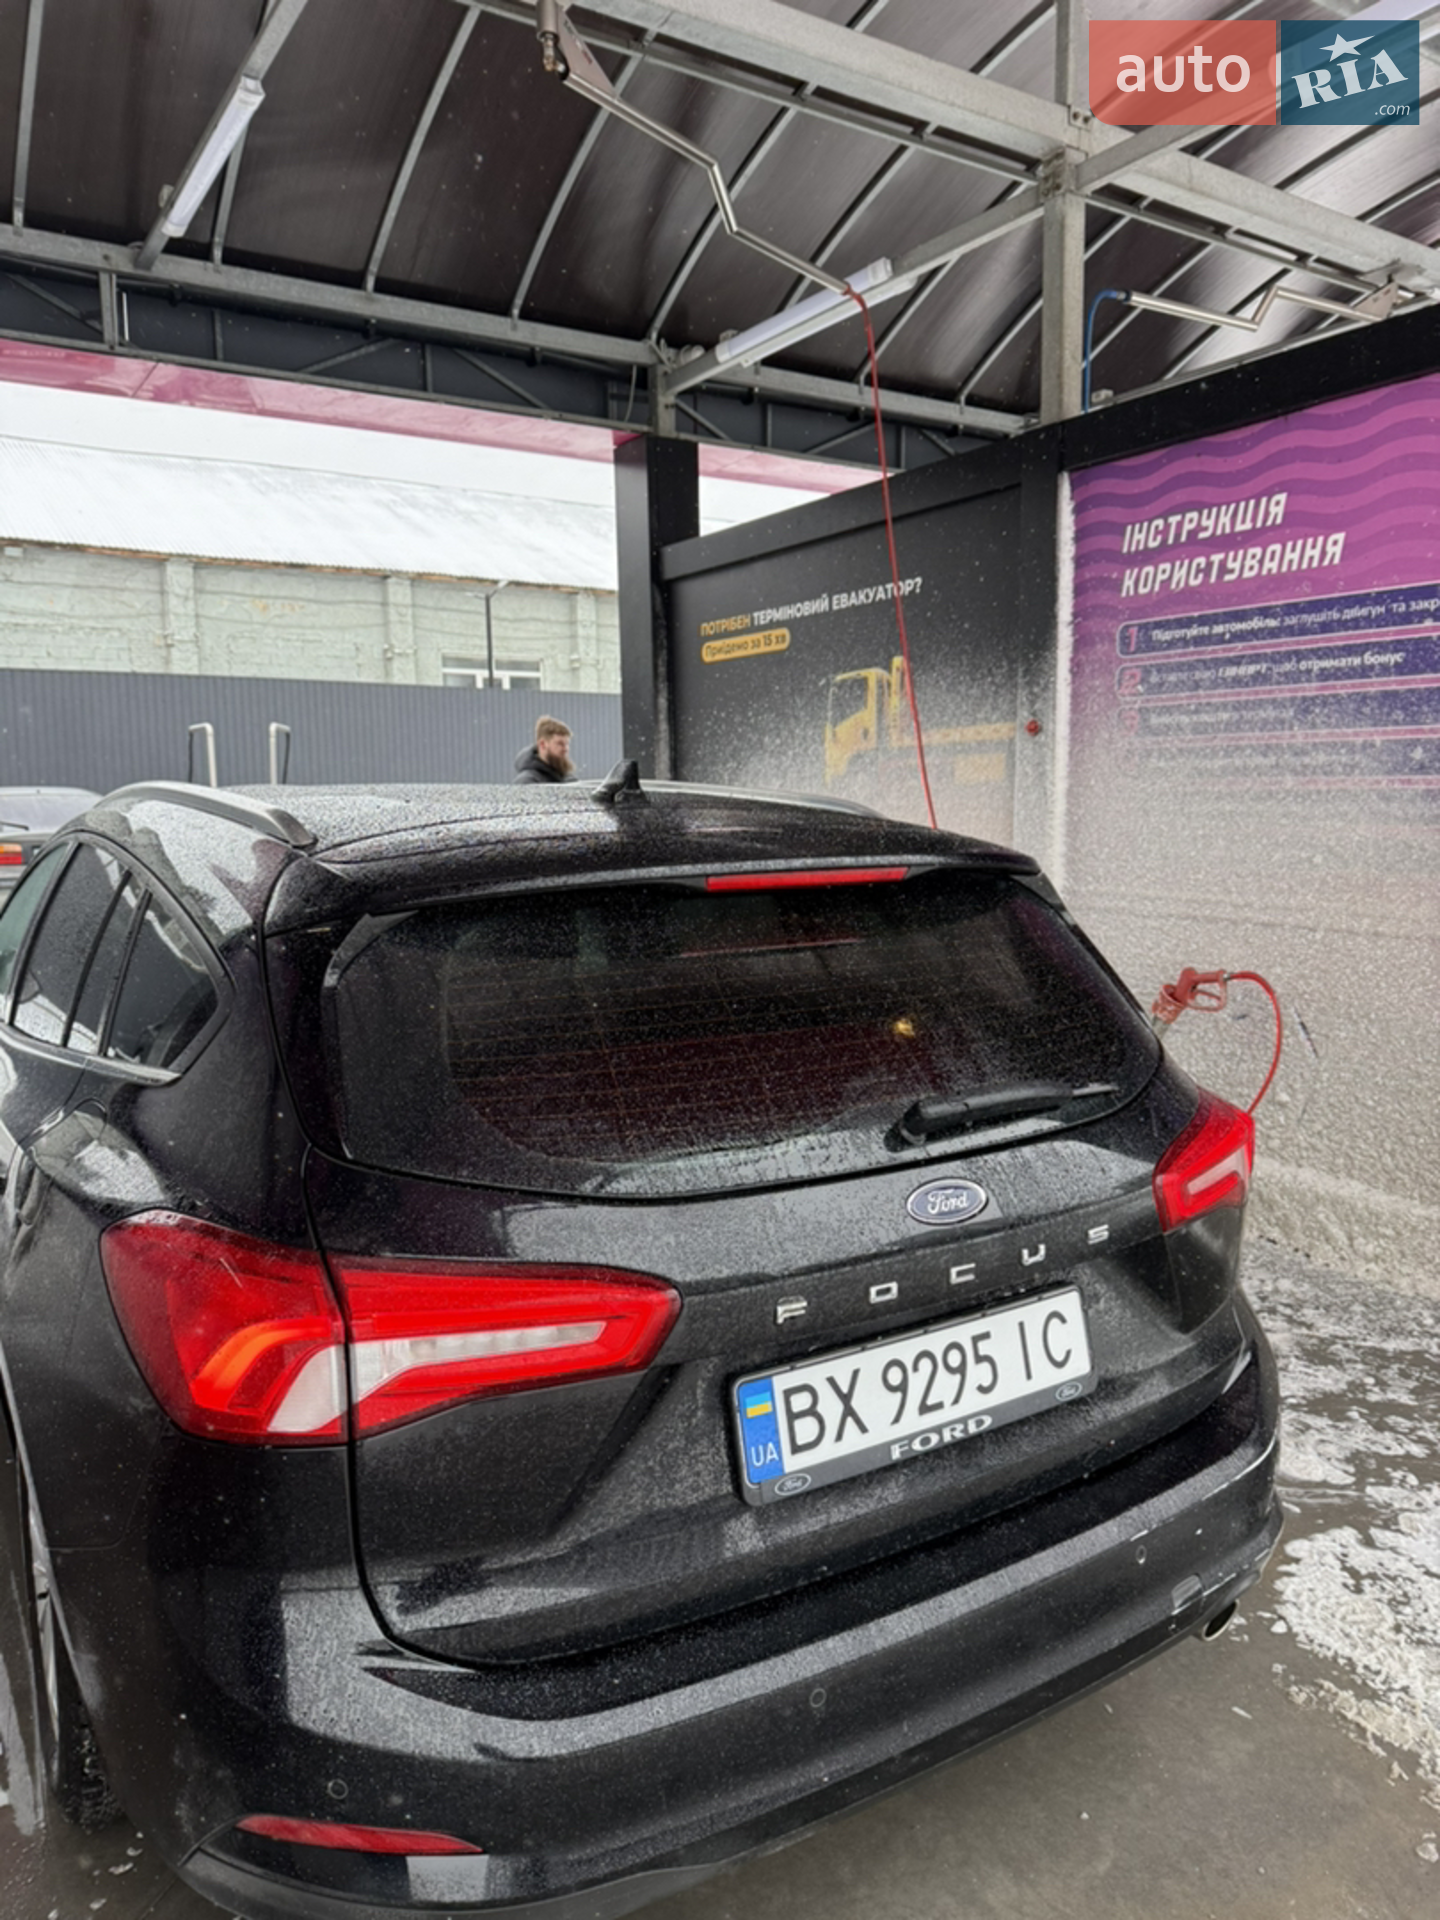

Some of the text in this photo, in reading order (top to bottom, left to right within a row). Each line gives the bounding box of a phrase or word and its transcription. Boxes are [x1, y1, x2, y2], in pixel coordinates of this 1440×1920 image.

[1121, 492, 1288, 553] ІНСТРУКЦІЯ
[1120, 532, 1346, 597] КОРИСТУВАННЯ
[700, 576, 923, 637] ПОТРІБЕН ТЕРМІНОВИЙ ЕВАКУАТОР?
[1126, 626, 1139, 652] 1
[1391, 601, 1407, 613] та
[705, 633, 786, 658] Приїдемо за 15 хв
[1363, 651, 1404, 667] бонус
[927, 1188, 970, 1215] Ford
[776, 1224, 1109, 1324] FOCUS
[782, 1310, 1072, 1456] BX 9295 IC
[751, 1442, 779, 1467] UA
[890, 1414, 993, 1461] FORD
